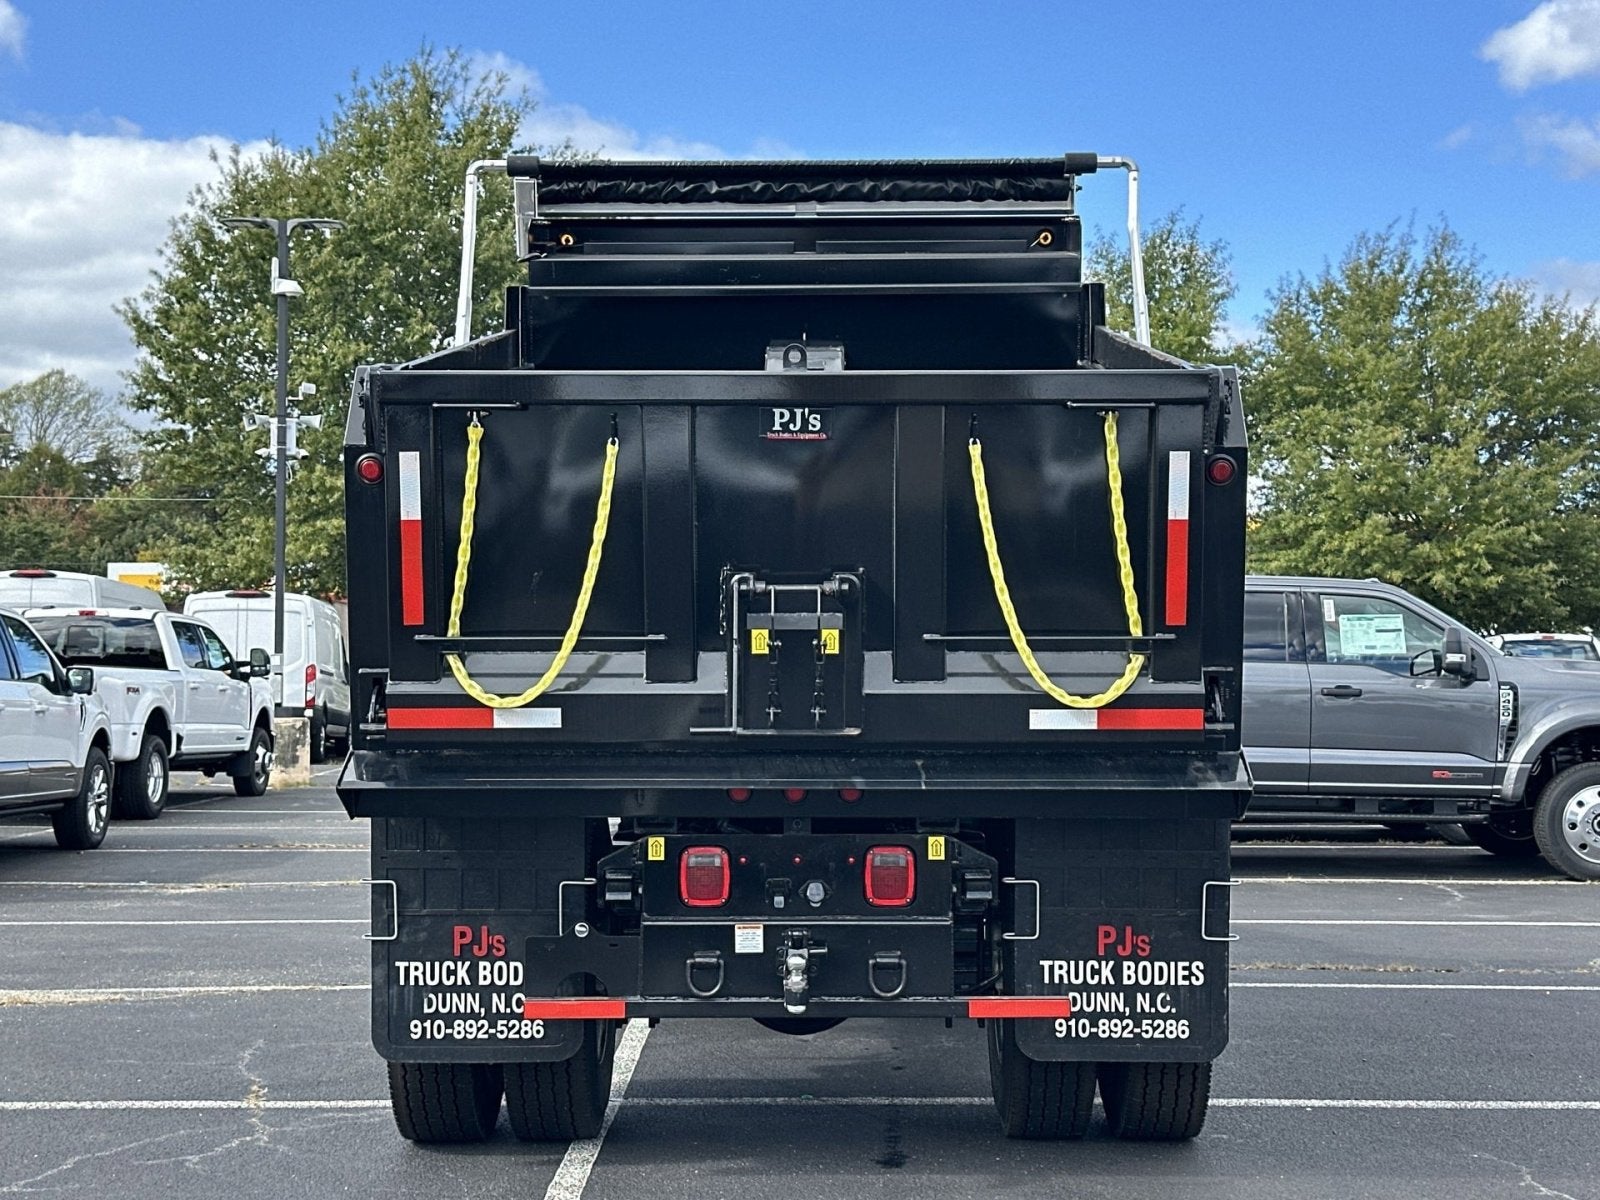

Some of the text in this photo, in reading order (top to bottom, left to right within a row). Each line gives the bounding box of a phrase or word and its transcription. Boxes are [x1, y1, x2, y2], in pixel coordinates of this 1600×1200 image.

[772, 407, 821, 431] PJ's
[453, 925, 506, 957] PJ's
[1097, 925, 1150, 956] PJ's
[395, 961, 524, 986] TRUCK BOD
[1040, 960, 1205, 986] TRUCK BODIES
[423, 992, 486, 1018] DUNN,
[1069, 992, 1177, 1017] DUNN, N.C.
[409, 1019, 545, 1040] 910-892-5286
[1055, 1018, 1190, 1039] 910-892-5286
